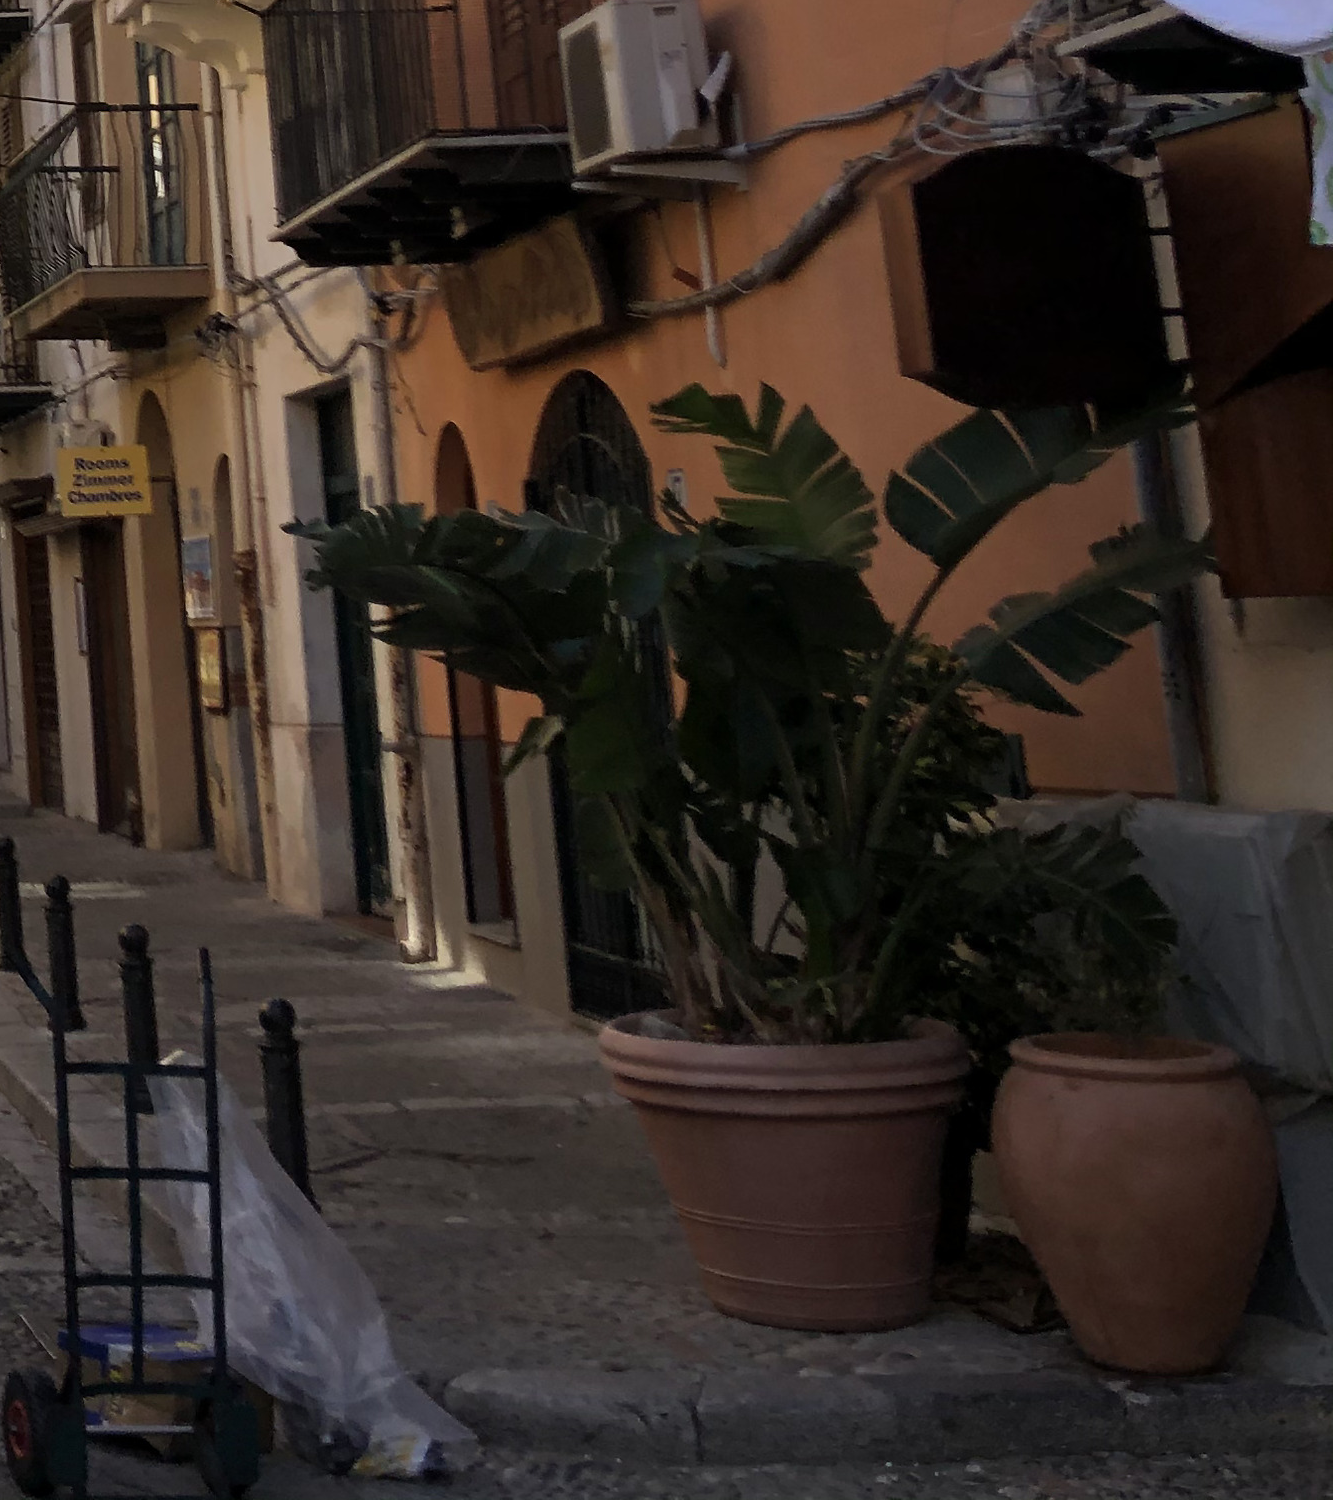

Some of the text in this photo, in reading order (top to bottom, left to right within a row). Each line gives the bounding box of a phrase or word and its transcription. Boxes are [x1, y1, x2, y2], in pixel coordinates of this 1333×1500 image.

[74, 458, 130, 471] Rooms
[73, 474, 134, 487] Zimmer
[68, 490, 144, 504] Chambres
